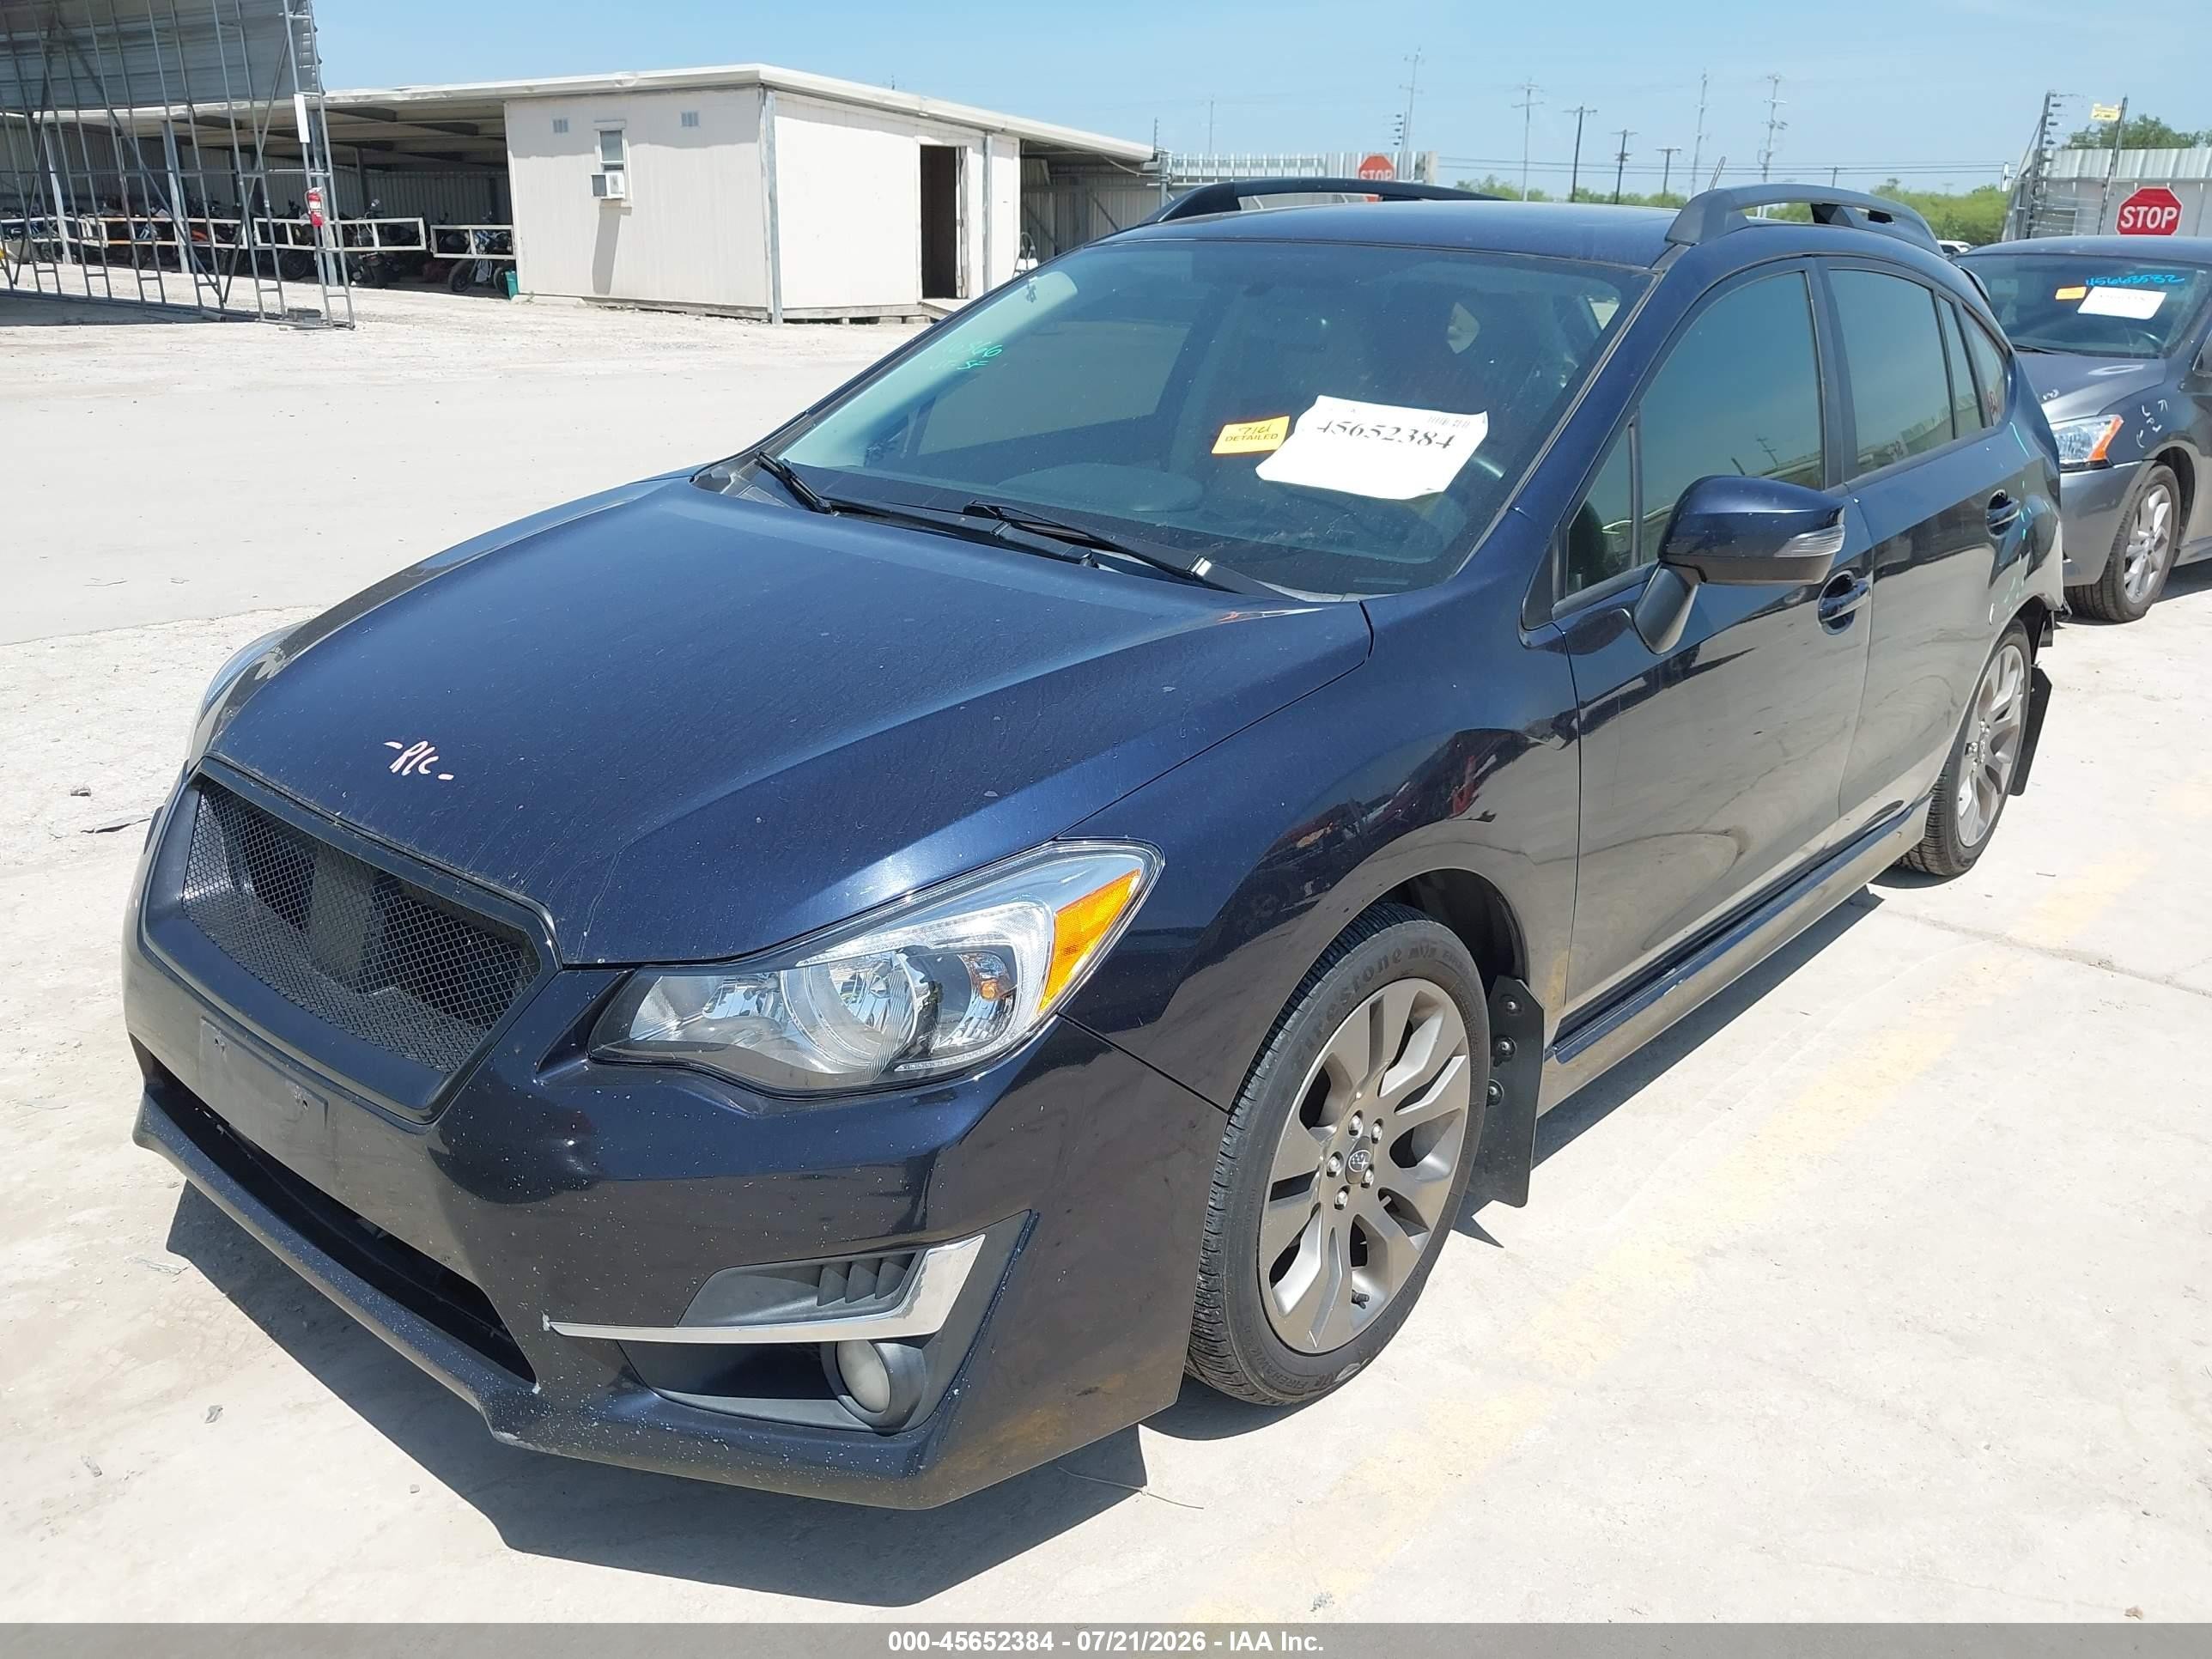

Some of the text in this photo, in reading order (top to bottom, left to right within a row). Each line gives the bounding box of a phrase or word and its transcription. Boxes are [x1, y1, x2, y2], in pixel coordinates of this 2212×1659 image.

[2120, 205, 2177, 228] STOP
[1224, 433, 1279, 442] DETAILED
[1316, 419, 1455, 449] 45652384
